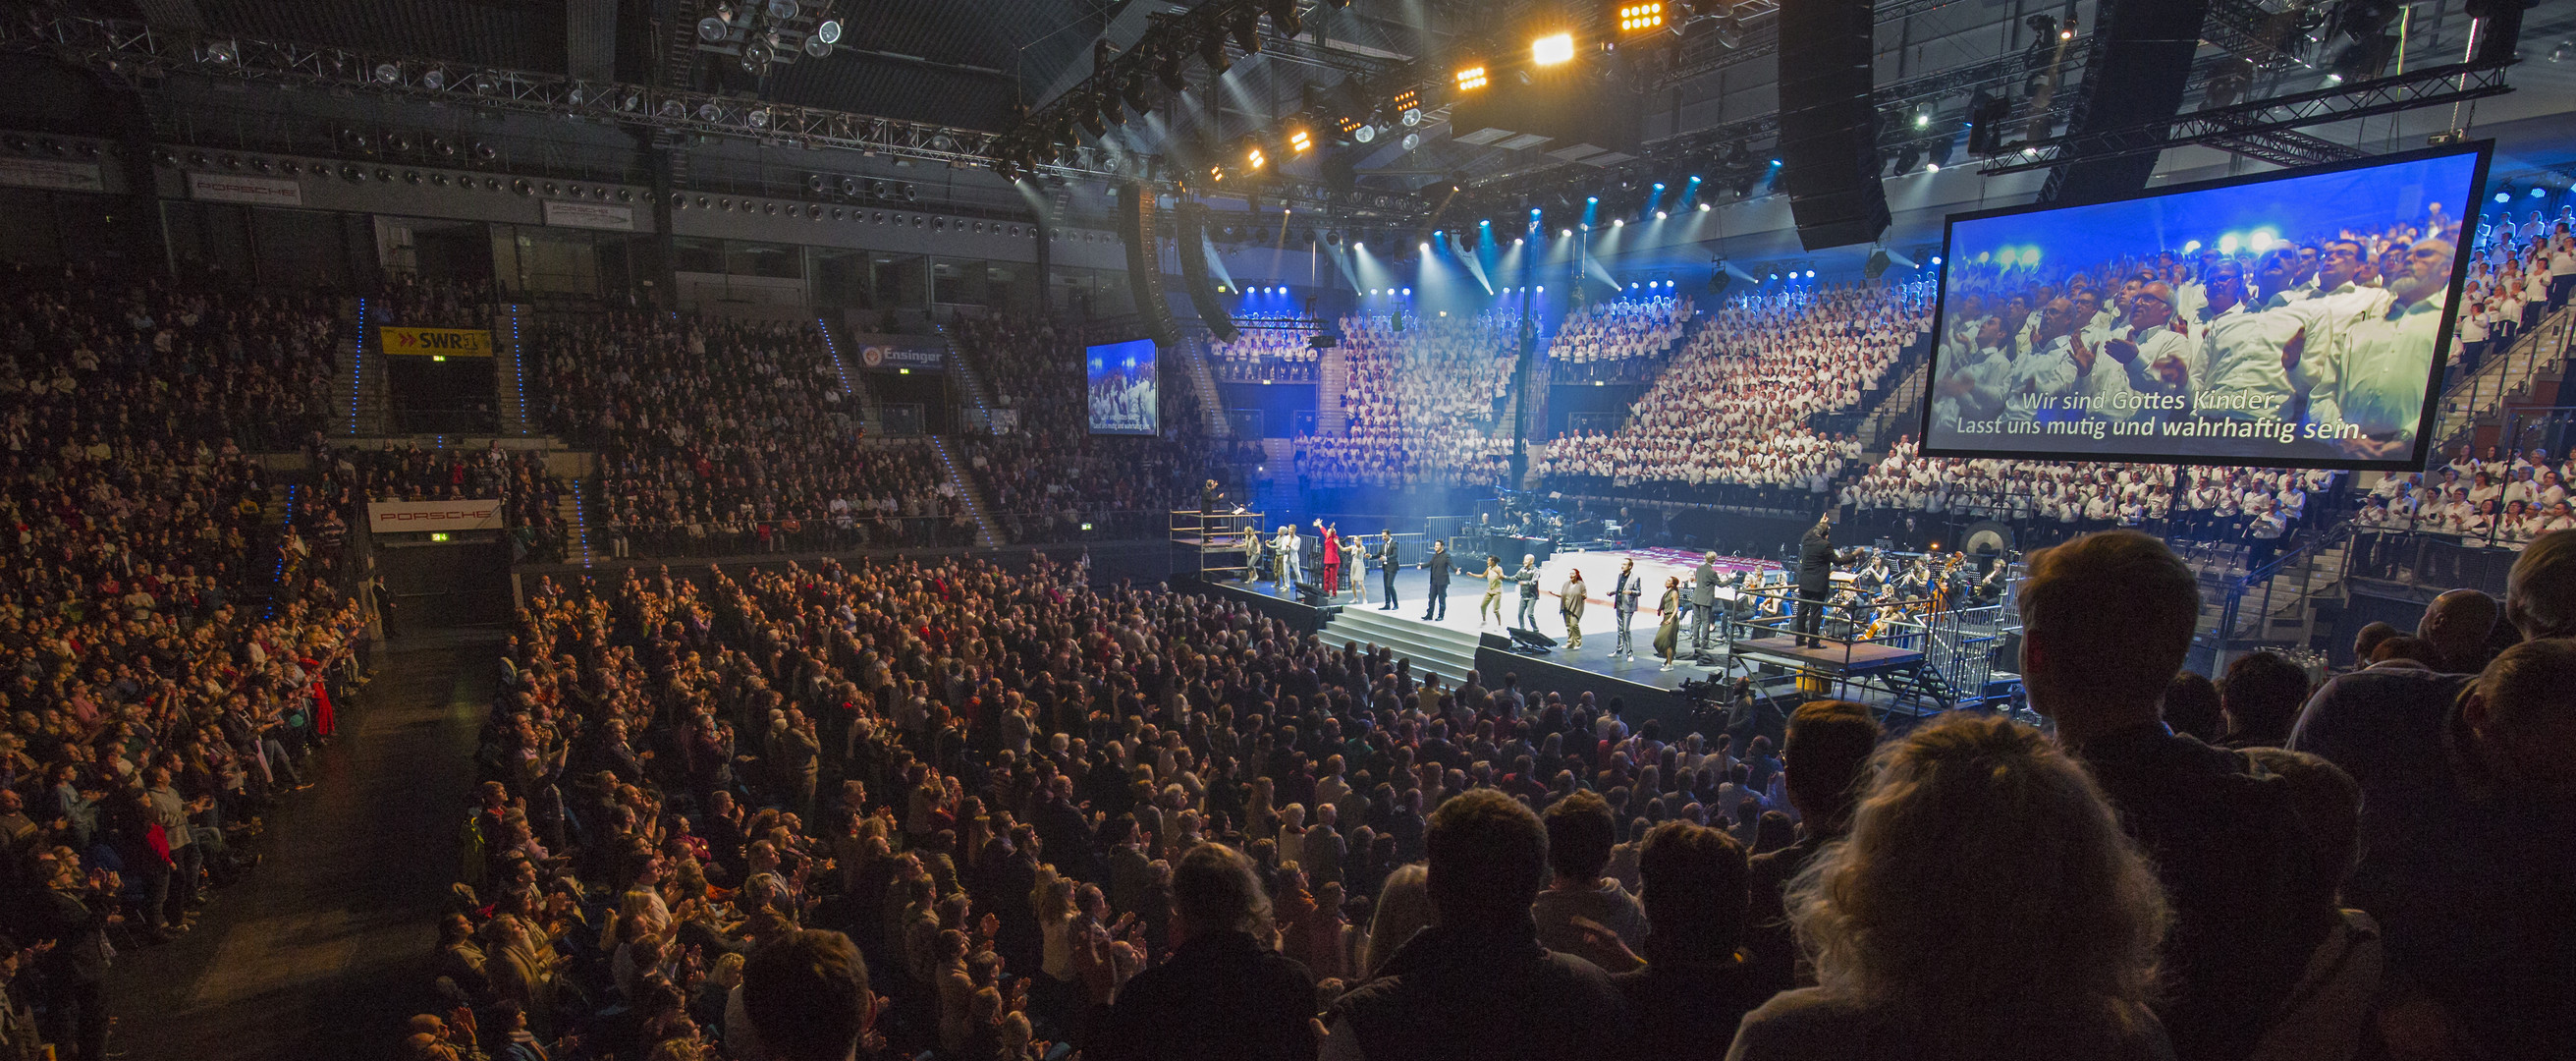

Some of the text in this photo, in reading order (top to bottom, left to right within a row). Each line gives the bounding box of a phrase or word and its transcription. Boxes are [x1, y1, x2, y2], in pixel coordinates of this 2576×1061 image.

[197, 182, 296, 196] PORSCHE
[419, 332, 479, 351] SWR1
[884, 347, 943, 363] Ensinger
[2022, 389, 2281, 410] Wir sind Gottes Kinder.
[1956, 417, 2369, 444] Lasst uns mutig und wahrhaftig sein.
[380, 511, 492, 522] PORSCHE
